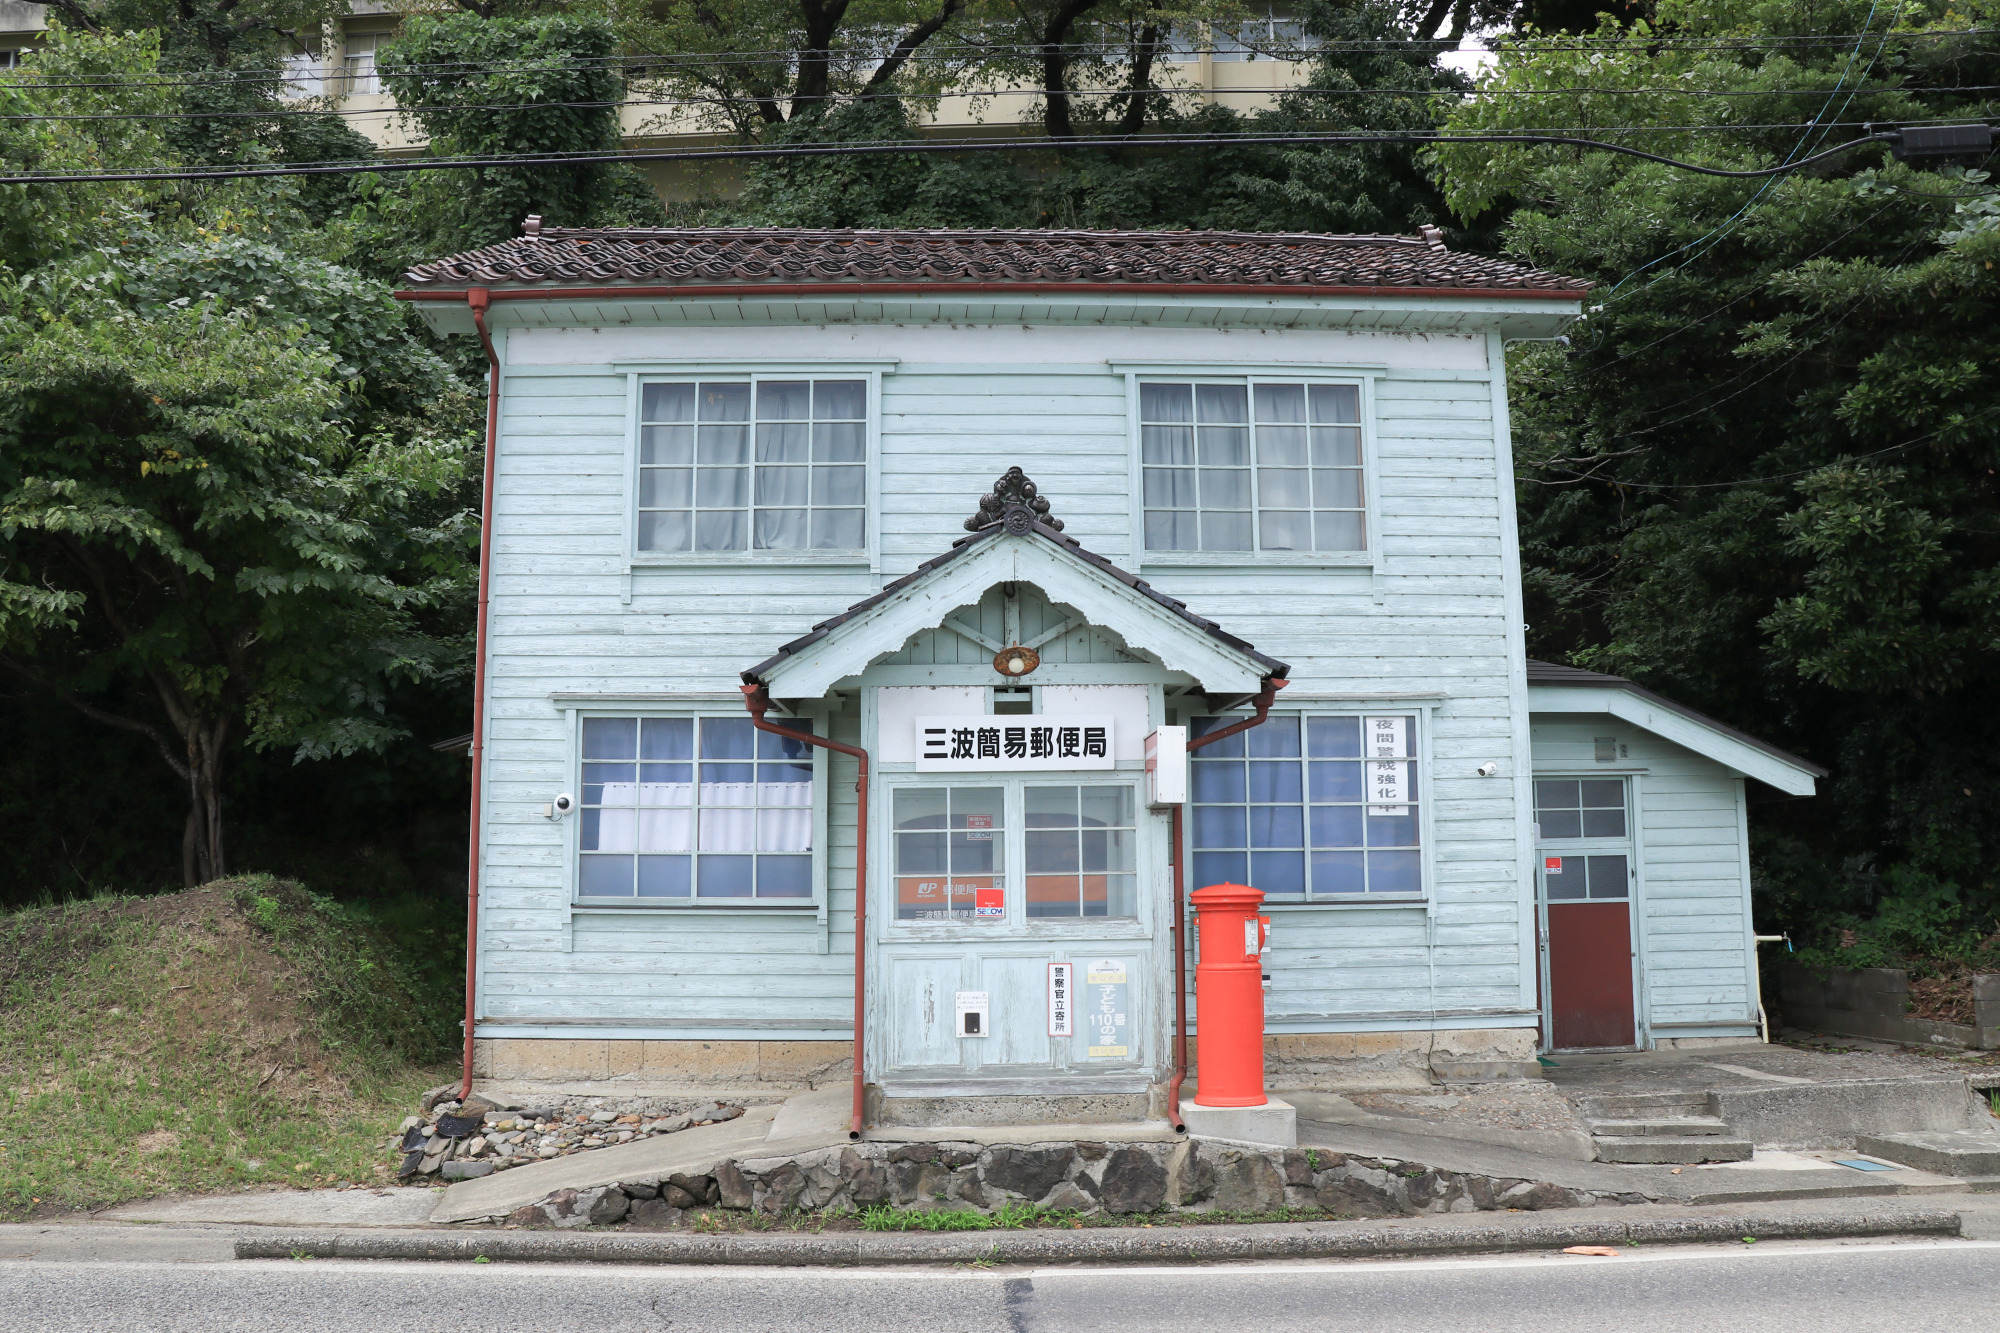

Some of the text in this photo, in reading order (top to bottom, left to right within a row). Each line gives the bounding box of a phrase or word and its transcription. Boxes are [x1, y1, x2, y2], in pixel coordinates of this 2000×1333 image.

[923, 726, 1107, 759] 三波簡易郵便局
[943, 884, 976, 895] 郵便局
[1054, 967, 1065, 1032] 警察官立寄所
